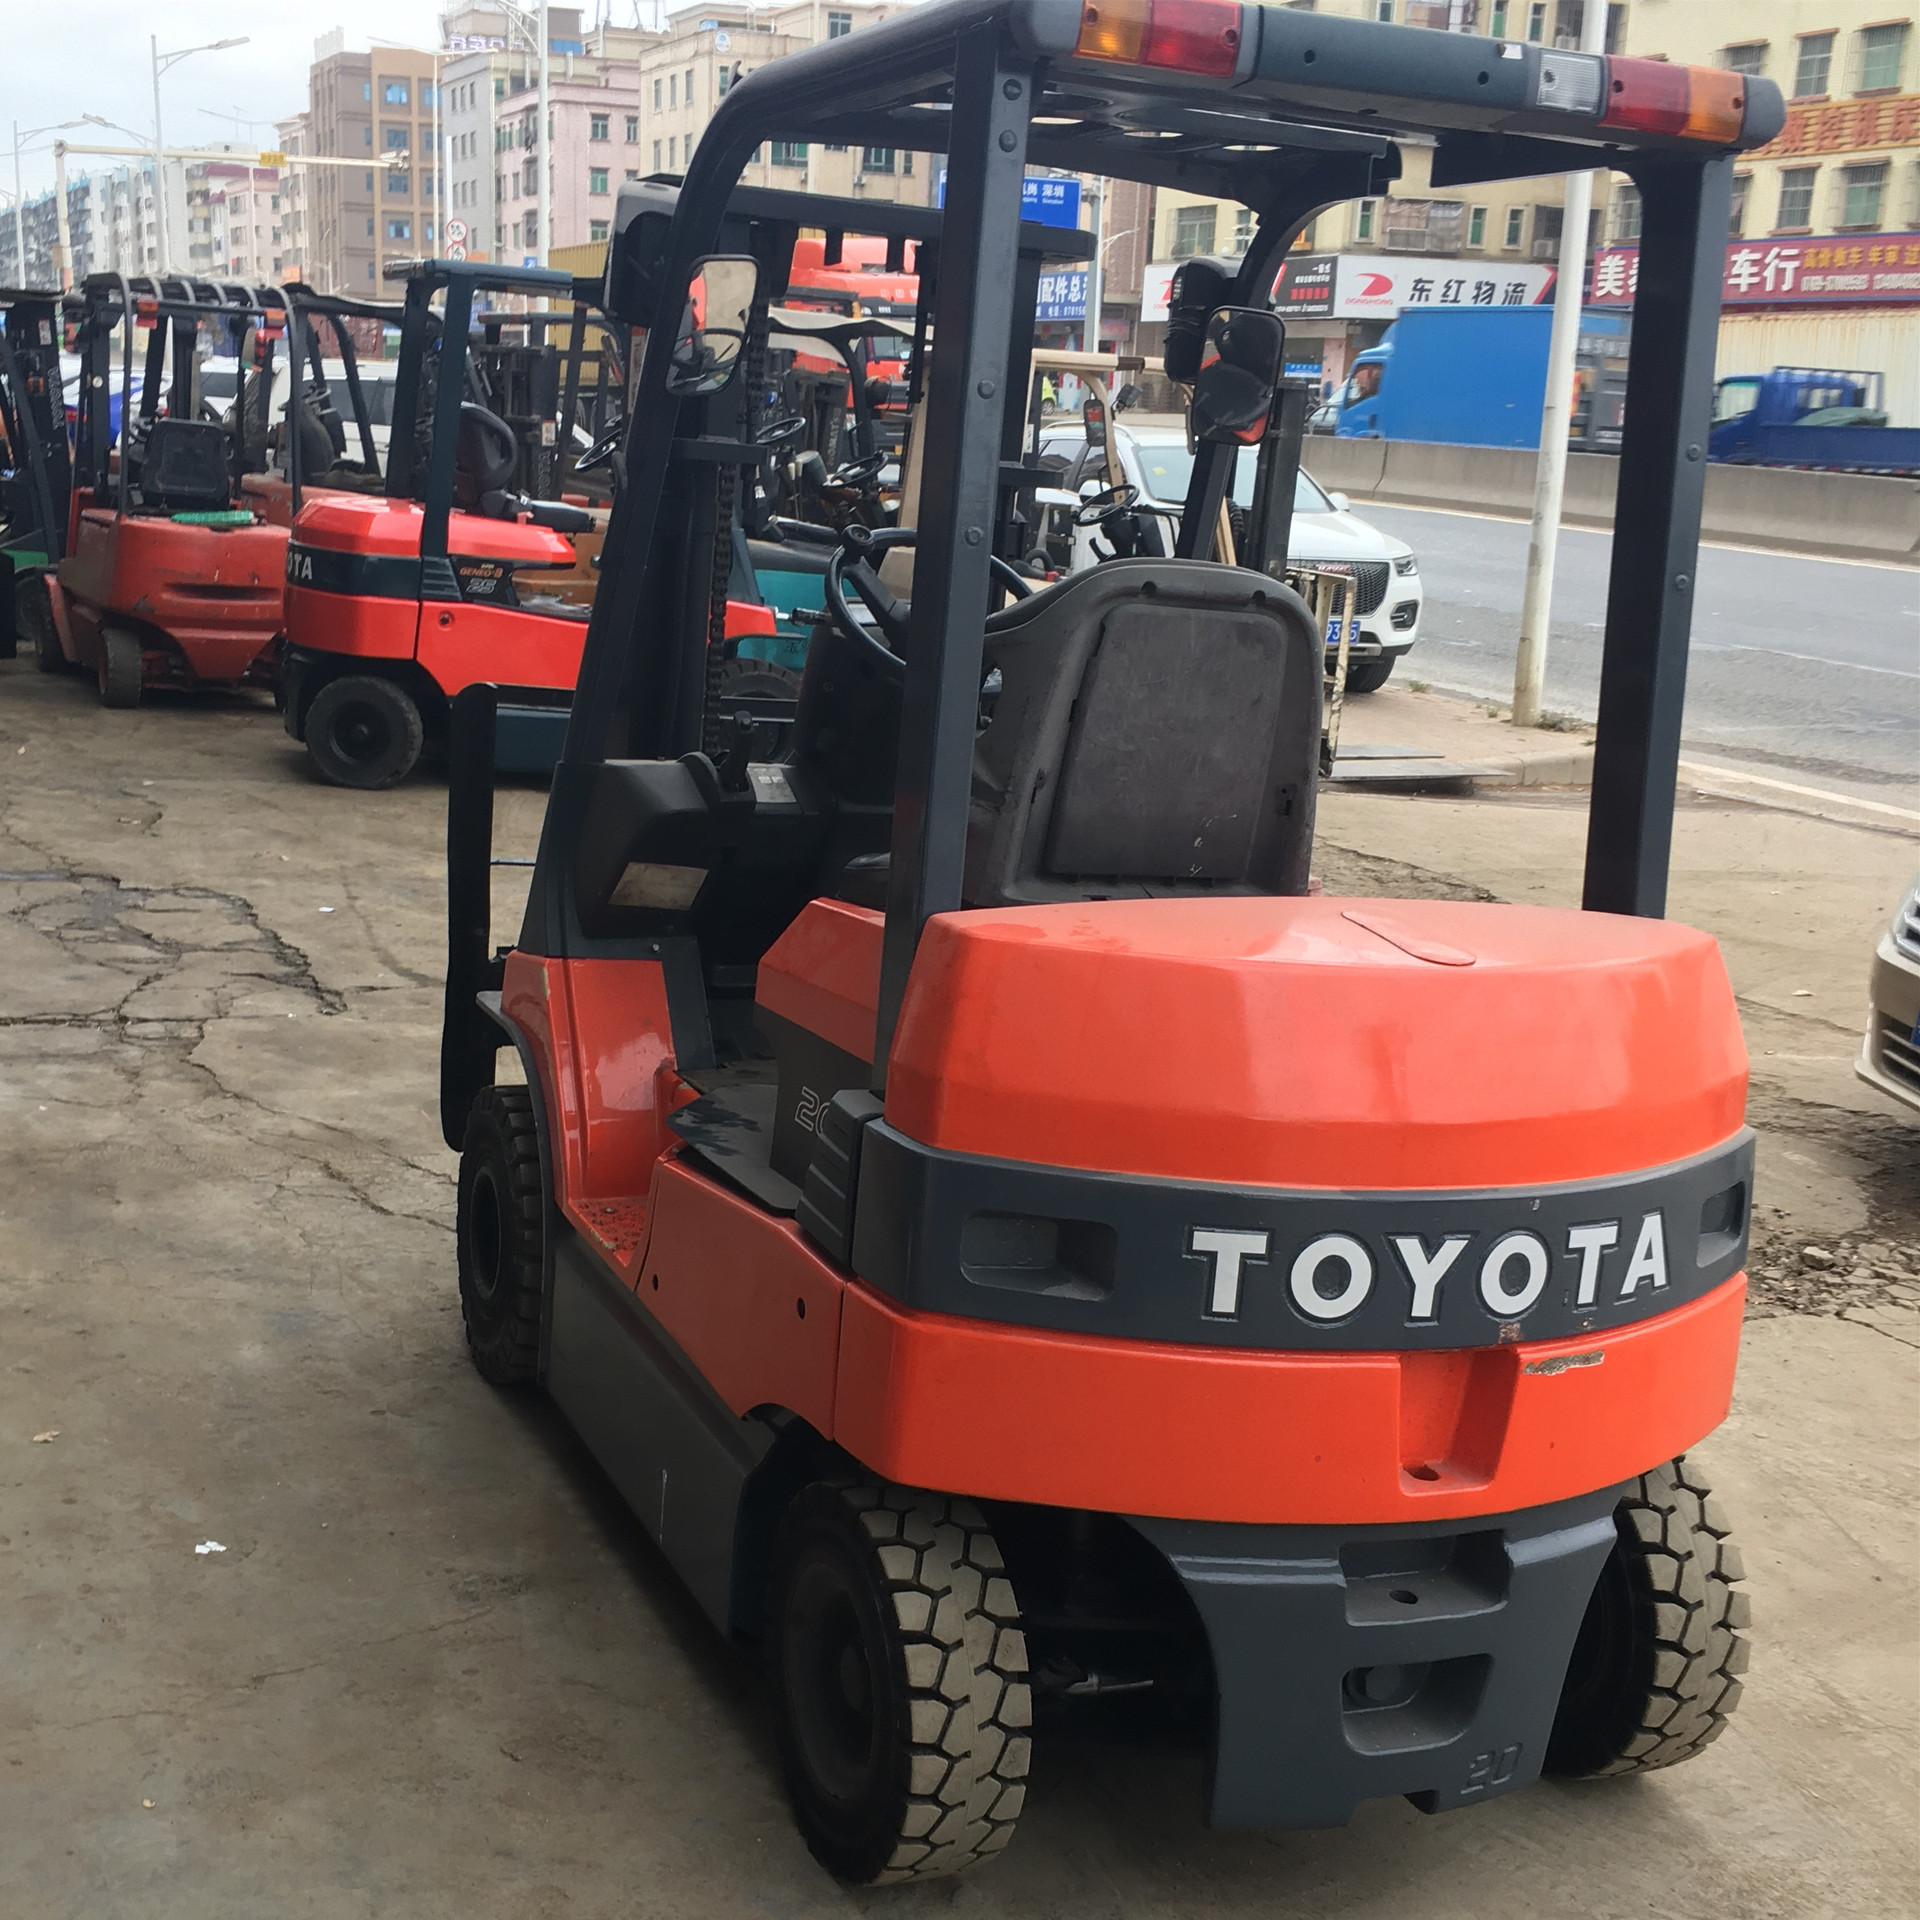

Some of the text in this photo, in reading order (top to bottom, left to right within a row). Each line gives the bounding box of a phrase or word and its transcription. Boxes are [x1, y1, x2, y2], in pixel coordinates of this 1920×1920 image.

[1408, 277, 1527, 306] 东红物流
[1728, 247, 1800, 292] 车行
[1190, 1212, 1668, 1322] TOYOTA
